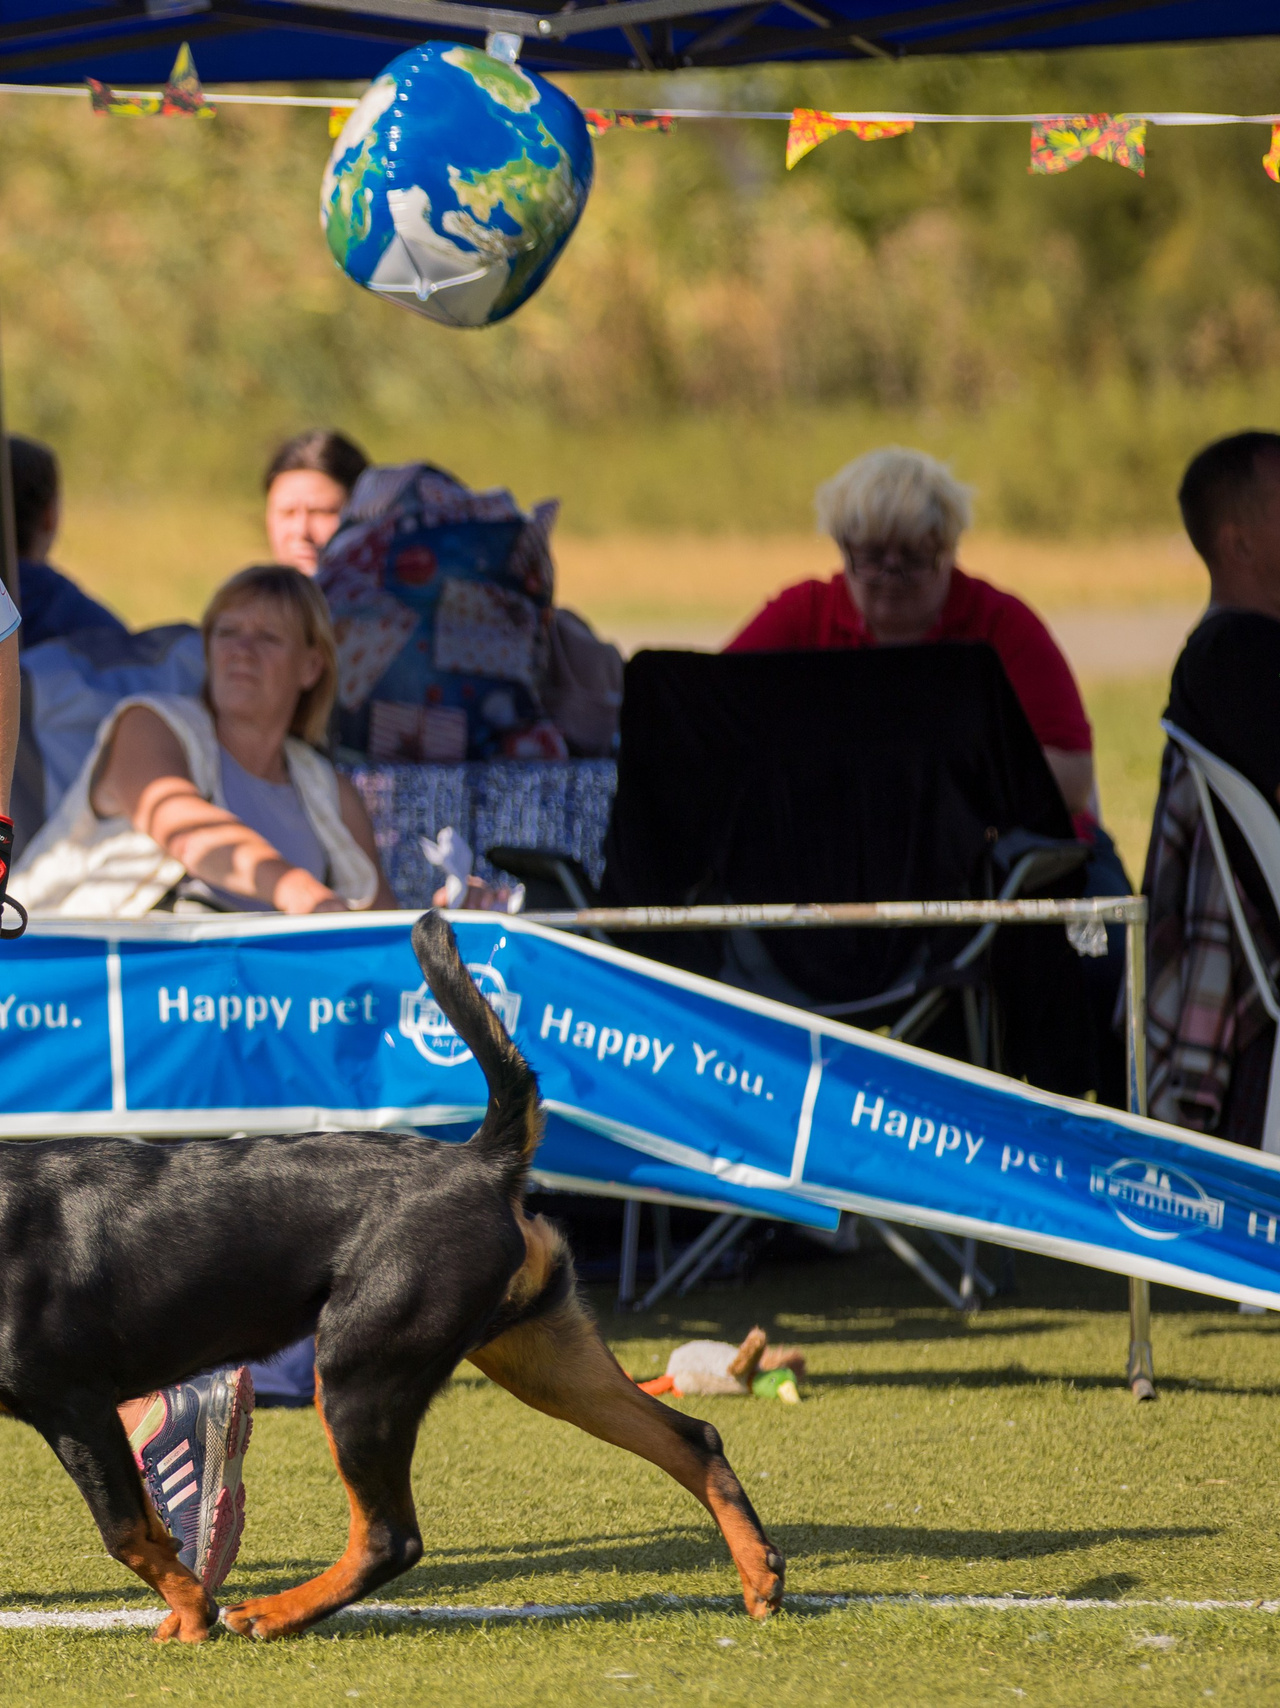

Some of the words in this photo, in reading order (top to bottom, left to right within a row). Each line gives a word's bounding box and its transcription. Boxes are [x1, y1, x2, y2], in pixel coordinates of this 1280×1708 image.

[158, 985, 292, 1031] Happy
[309, 990, 379, 1034] pet
[540, 1003, 675, 1074] Happy
[692, 1041, 774, 1101] You.
[851, 1091, 985, 1164] Happy
[1000, 1143, 1068, 1183] pet
